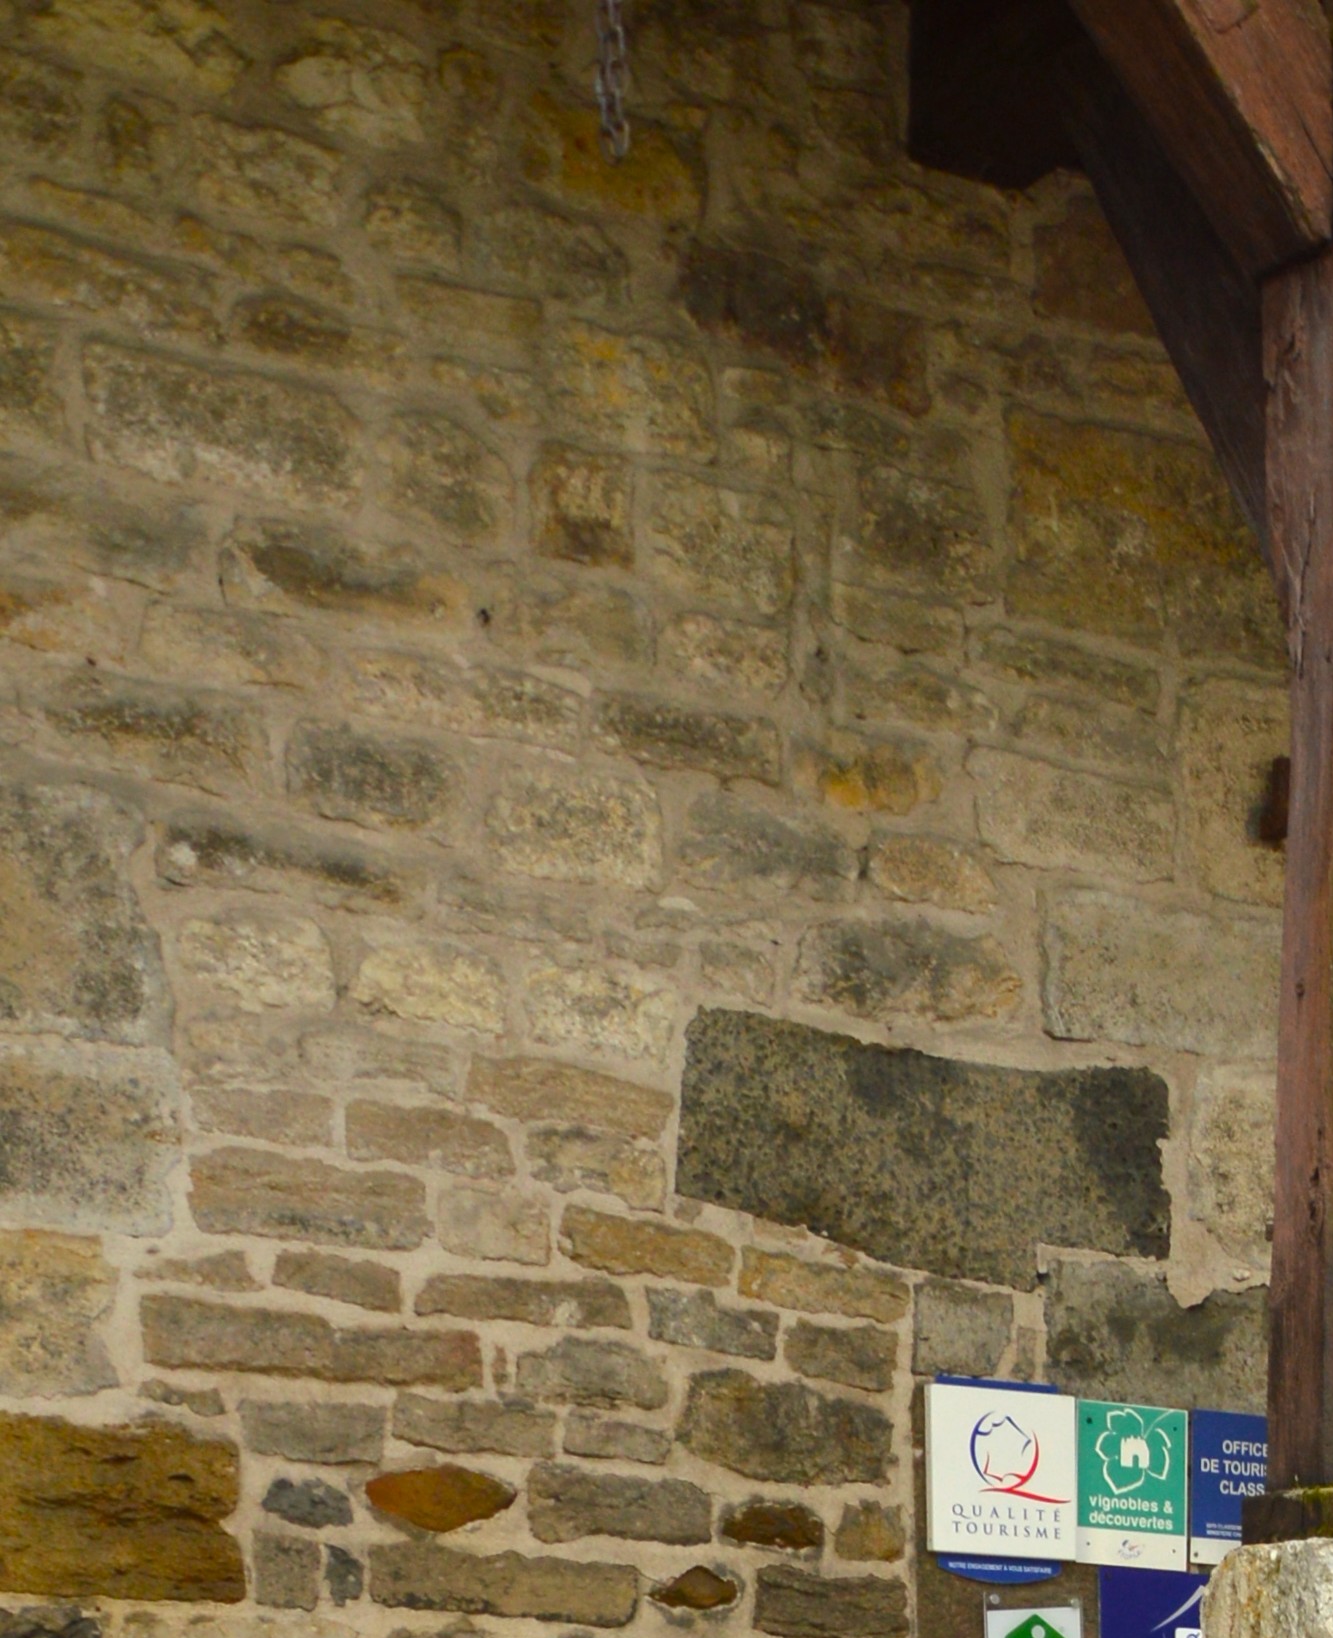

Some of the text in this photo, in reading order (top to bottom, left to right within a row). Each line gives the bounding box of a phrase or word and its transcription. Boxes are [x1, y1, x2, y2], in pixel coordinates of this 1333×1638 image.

[1200, 1457, 1267, 1477] DE TOURI
[1219, 1479, 1266, 1497] CLASS
[951, 1503, 1061, 1523] QUALITÉ
[1089, 1494, 1173, 1514] vignobles &
[951, 1521, 1061, 1540] TOURISME
[1089, 1510, 1174, 1531] découvertes
